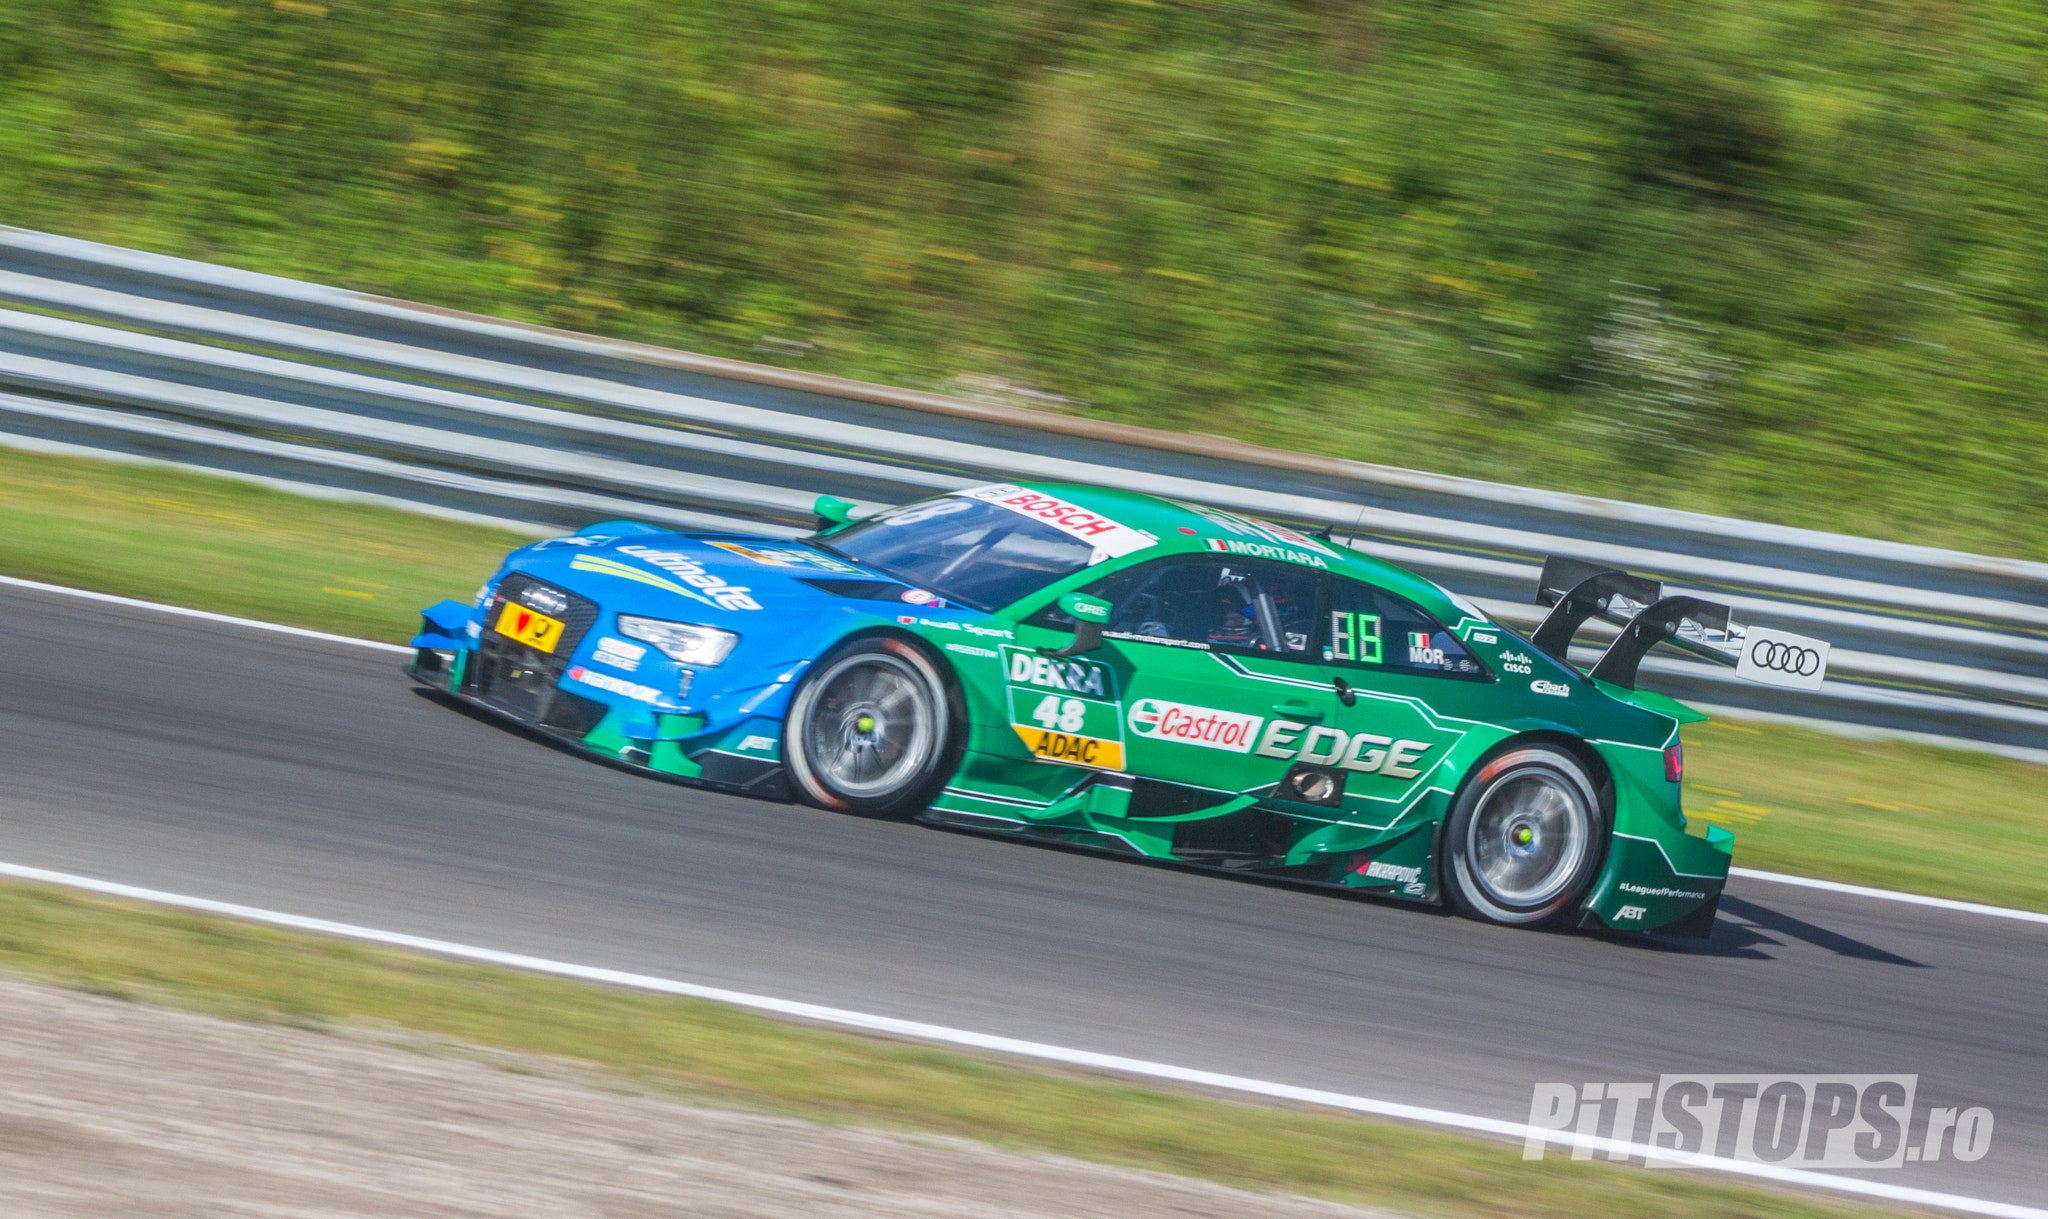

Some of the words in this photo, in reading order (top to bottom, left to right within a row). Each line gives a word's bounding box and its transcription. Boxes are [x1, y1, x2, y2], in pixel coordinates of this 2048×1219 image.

[1002, 493, 1118, 536] BOSCH
[1227, 539, 1328, 570] MORTARA
[616, 545, 764, 611] ultimate
[1409, 647, 1444, 665] MOR
[1503, 662, 1532, 675] cisco
[1010, 652, 1105, 697] DEKRA
[1530, 679, 1570, 697] Eibach
[1032, 695, 1086, 733] 48
[1160, 706, 1252, 747] Castrol
[1035, 730, 1099, 764] ADAC
[1254, 718, 1434, 780] EDGE
[1619, 882, 1705, 900] #LeagueofPerformance
[1612, 904, 1648, 921] ABT
